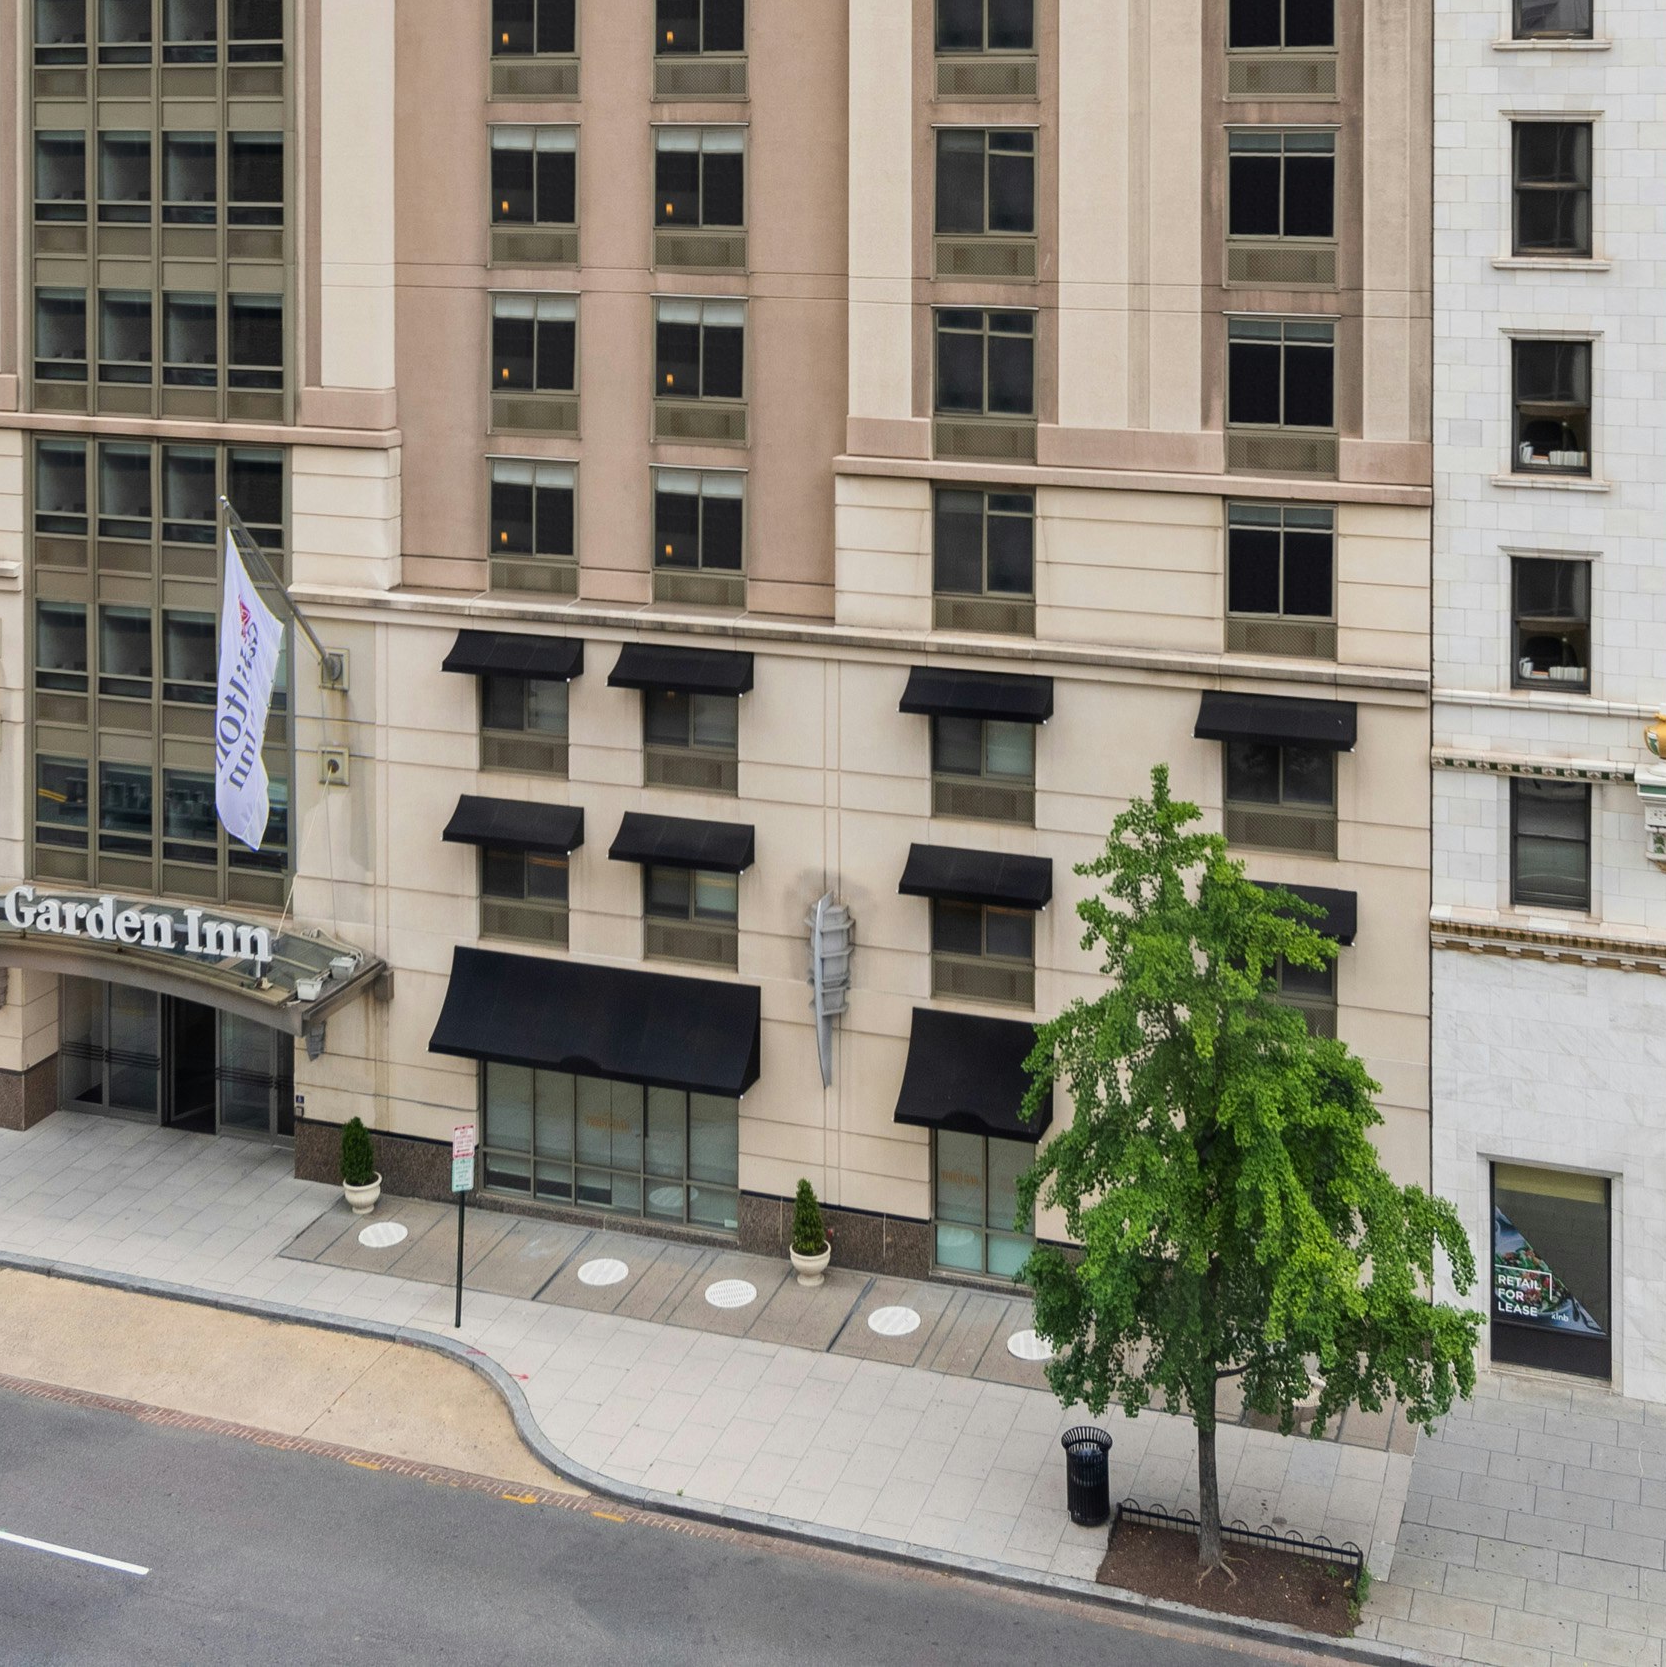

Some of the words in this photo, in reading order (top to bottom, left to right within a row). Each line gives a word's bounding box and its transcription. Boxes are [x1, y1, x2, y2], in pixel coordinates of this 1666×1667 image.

[4, 885, 175, 949] Garden
[184, 908, 272, 962] Inn
[1498, 1274, 1541, 1290] RETAIL
[1498, 1288, 1524, 1301] FOR
[1498, 1301, 1538, 1317] LEASE
